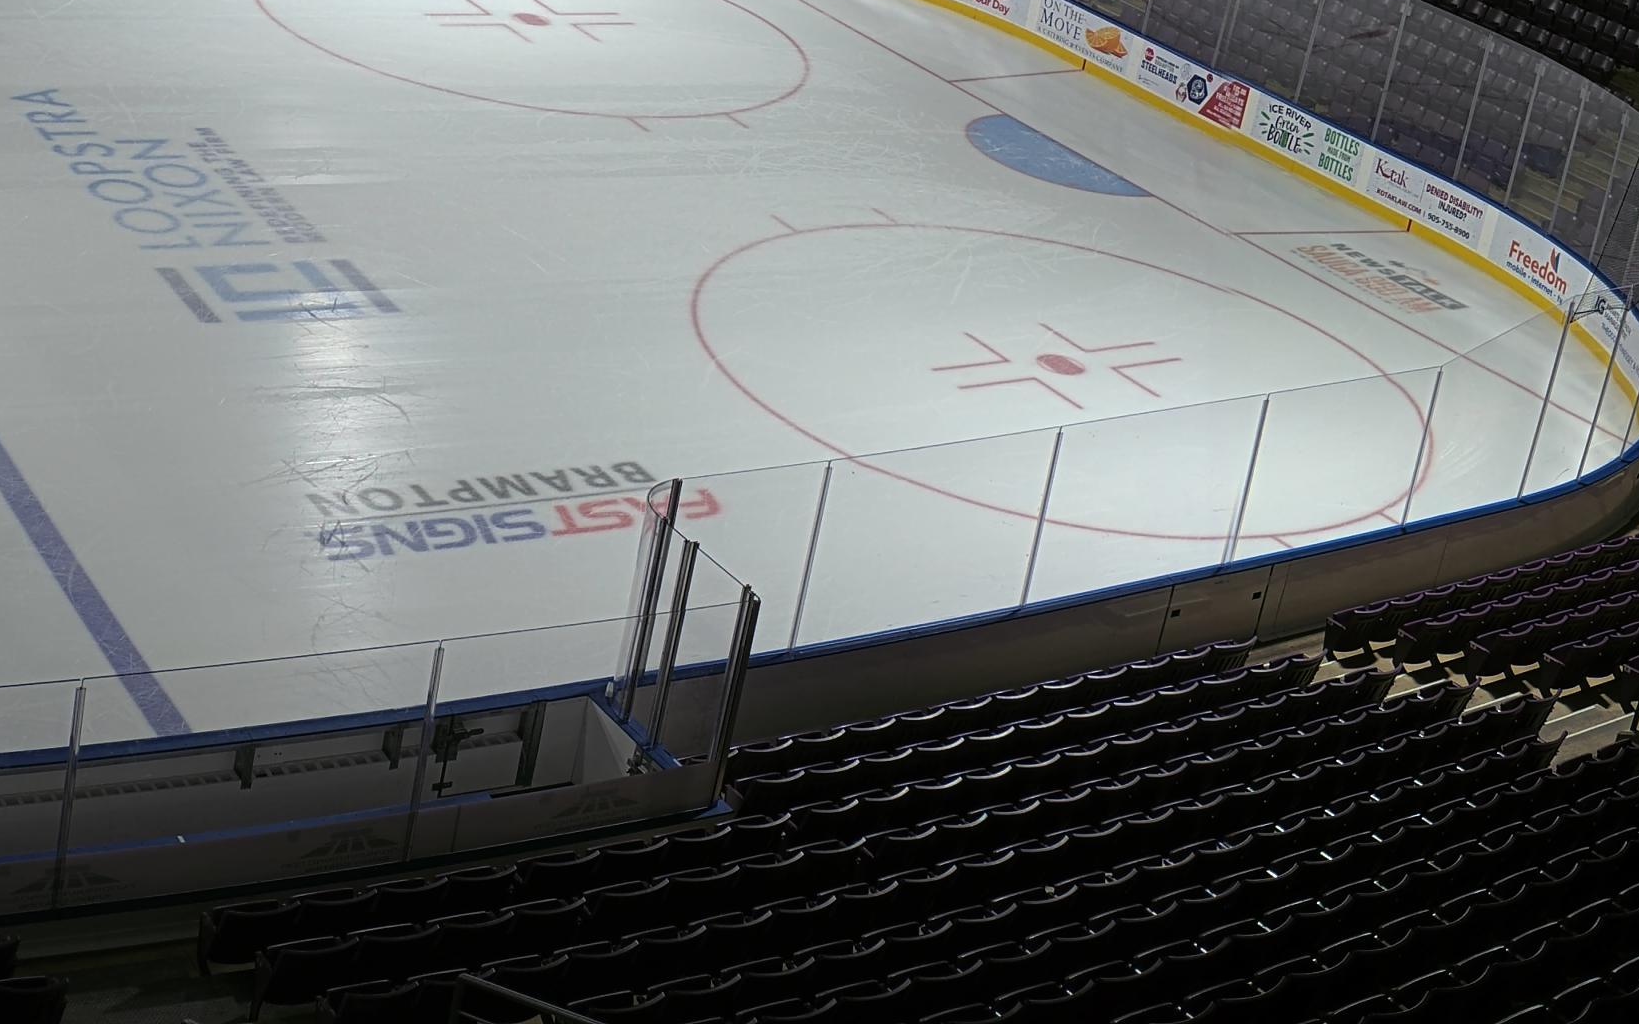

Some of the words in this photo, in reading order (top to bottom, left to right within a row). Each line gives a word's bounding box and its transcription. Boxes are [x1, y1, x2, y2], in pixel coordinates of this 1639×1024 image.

[1040, 7, 1083, 41] MOVE
[1062, 1, 1085, 25] THE
[1140, 59, 1178, 85] STEELHEADS
[1269, 103, 1284, 115] ICE
[1285, 106, 1312, 131] RIVER
[1324, 127, 1360, 157] BOTTLES
[11, 88, 203, 250] LOOPSTRA
[1318, 152, 1353, 182] BOTTLES
[115, 137, 272, 247] NIXON
[1376, 187, 1421, 216] KOTAKLAW.COM
[1426, 183, 1448, 201] DENIED
[1449, 194, 1483, 220] DISABILITY?
[1438, 201, 1467, 222] INJURED?
[1330, 243, 1396, 275] NEWS
[1508, 239, 1567, 295] Freedom
[1506, 260, 1527, 279] mobile
[1531, 276, 1553, 297] internet
[306, 461, 658, 518] BRAMPTON
